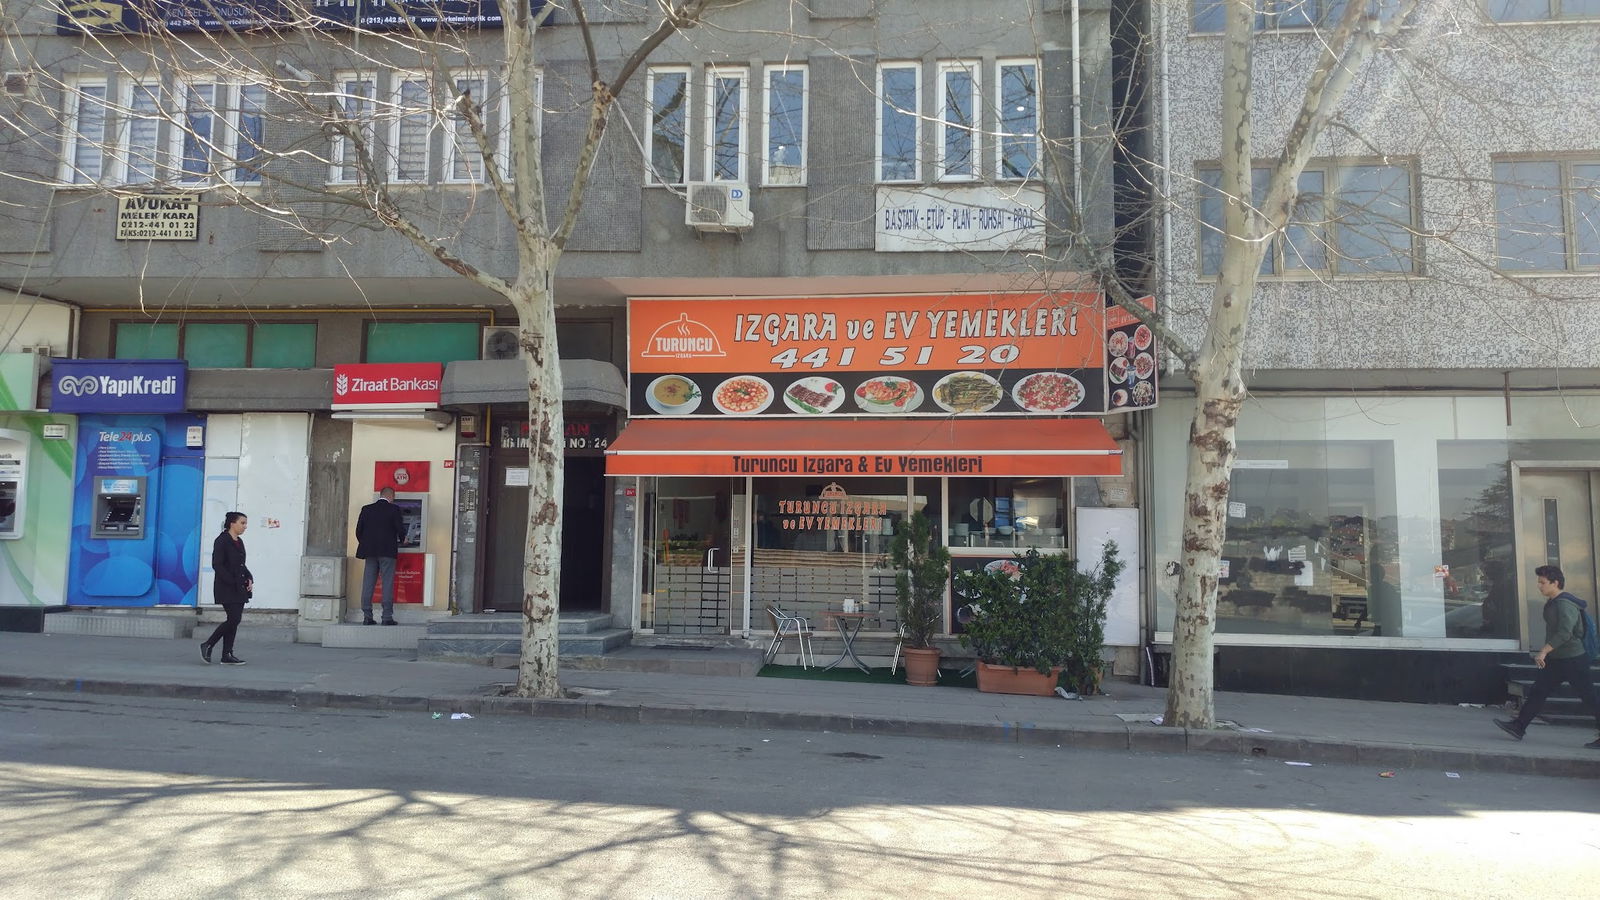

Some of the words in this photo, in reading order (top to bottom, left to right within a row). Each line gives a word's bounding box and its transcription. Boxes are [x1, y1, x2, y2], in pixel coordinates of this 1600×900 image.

[125, 197, 192, 210] AVUKAT
[120, 212, 159, 220] MELEK
[162, 212, 195, 220] KARA
[952, 208, 971, 230] PLAN
[121, 221, 165, 229] 0212-441
[169, 221, 180, 229] 01
[183, 221, 195, 229] 23
[174, 229, 182, 238] 01
[185, 229, 194, 238] 23
[733, 312, 838, 347] IZGARA
[845, 318, 876, 341] ve
[883, 310, 920, 340] EV
[655, 337, 713, 352] TURUNCU
[769, 346, 856, 370] 441
[878, 345, 935, 367] 51
[956, 343, 1021, 365] 20
[99, 375, 177, 398] YapıKredi
[351, 378, 389, 392] Ziraat
[390, 377, 438, 391] Bankası
[99, 431, 152, 445] Tele24plus
[569, 438, 586, 449] NO
[594, 438, 608, 449] 24
[732, 455, 798, 473] Turuncu
[803, 455, 853, 474] Izgara
[858, 455, 869, 473] &
[874, 455, 893, 473] Ev
[898, 454, 983, 473] Yemekleri
[778, 499, 838, 515] TURUNCU
[798, 516, 816, 530] EV
